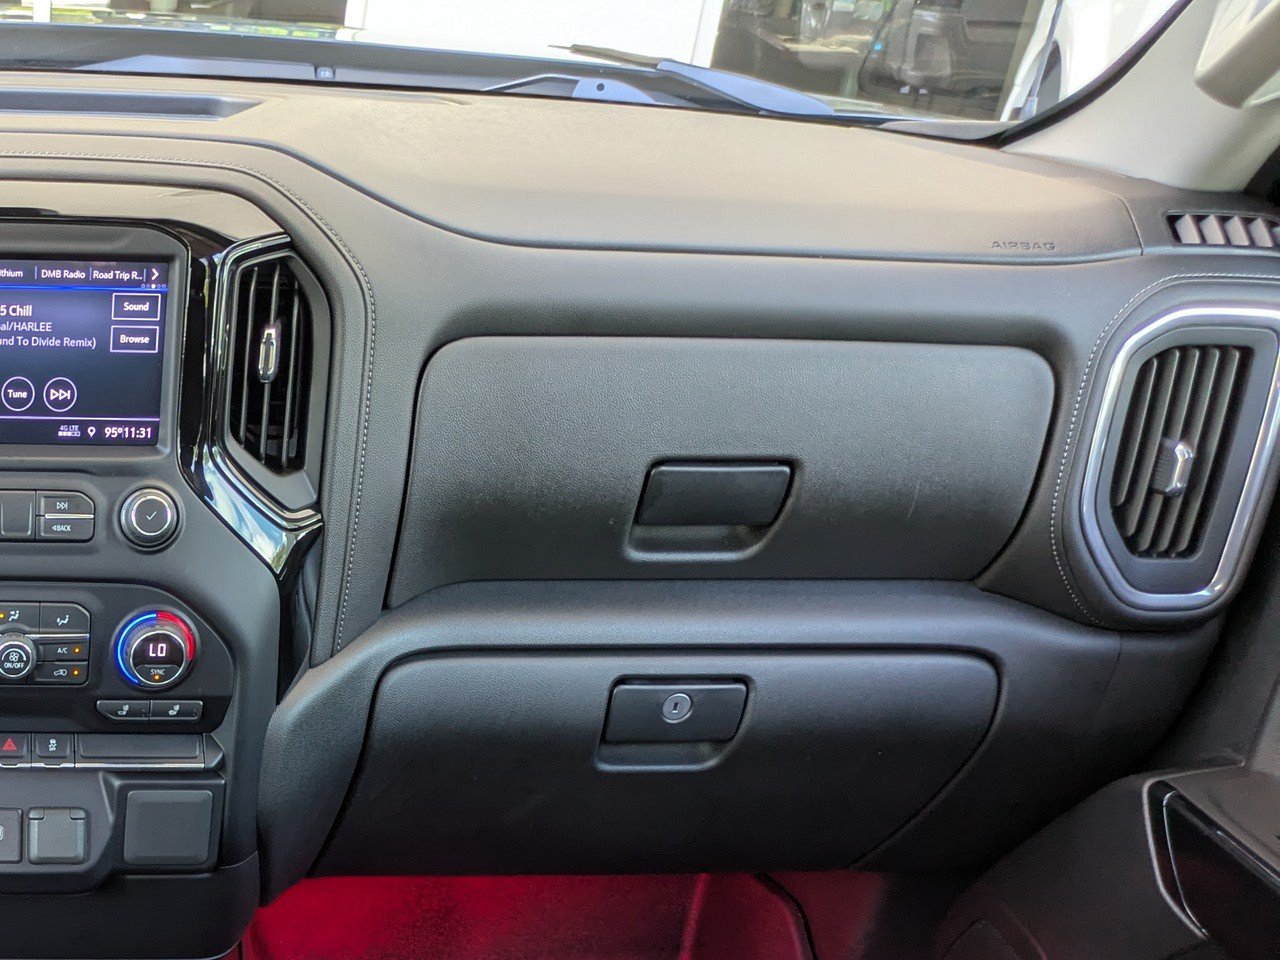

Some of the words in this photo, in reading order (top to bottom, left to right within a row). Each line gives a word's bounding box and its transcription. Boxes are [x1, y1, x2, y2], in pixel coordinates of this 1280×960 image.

[991, 240, 1056, 251] AIRBAG
[41, 270, 62, 279] DMB
[63, 270, 86, 279] Radio
[93, 271, 114, 279] Road
[115, 271, 130, 282] Trip
[9, 305, 32, 317] Chill
[123, 302, 149, 311] Sound
[16, 336, 29, 346] To
[31, 336, 61, 347] Divide
[63, 337, 97, 349] Remix)
[120, 335, 150, 344] Browse
[7, 389, 28, 399] Tune
[124, 427, 152, 438] 11:31
[56, 524, 72, 532] BACK
[149, 643, 167, 657] LO
